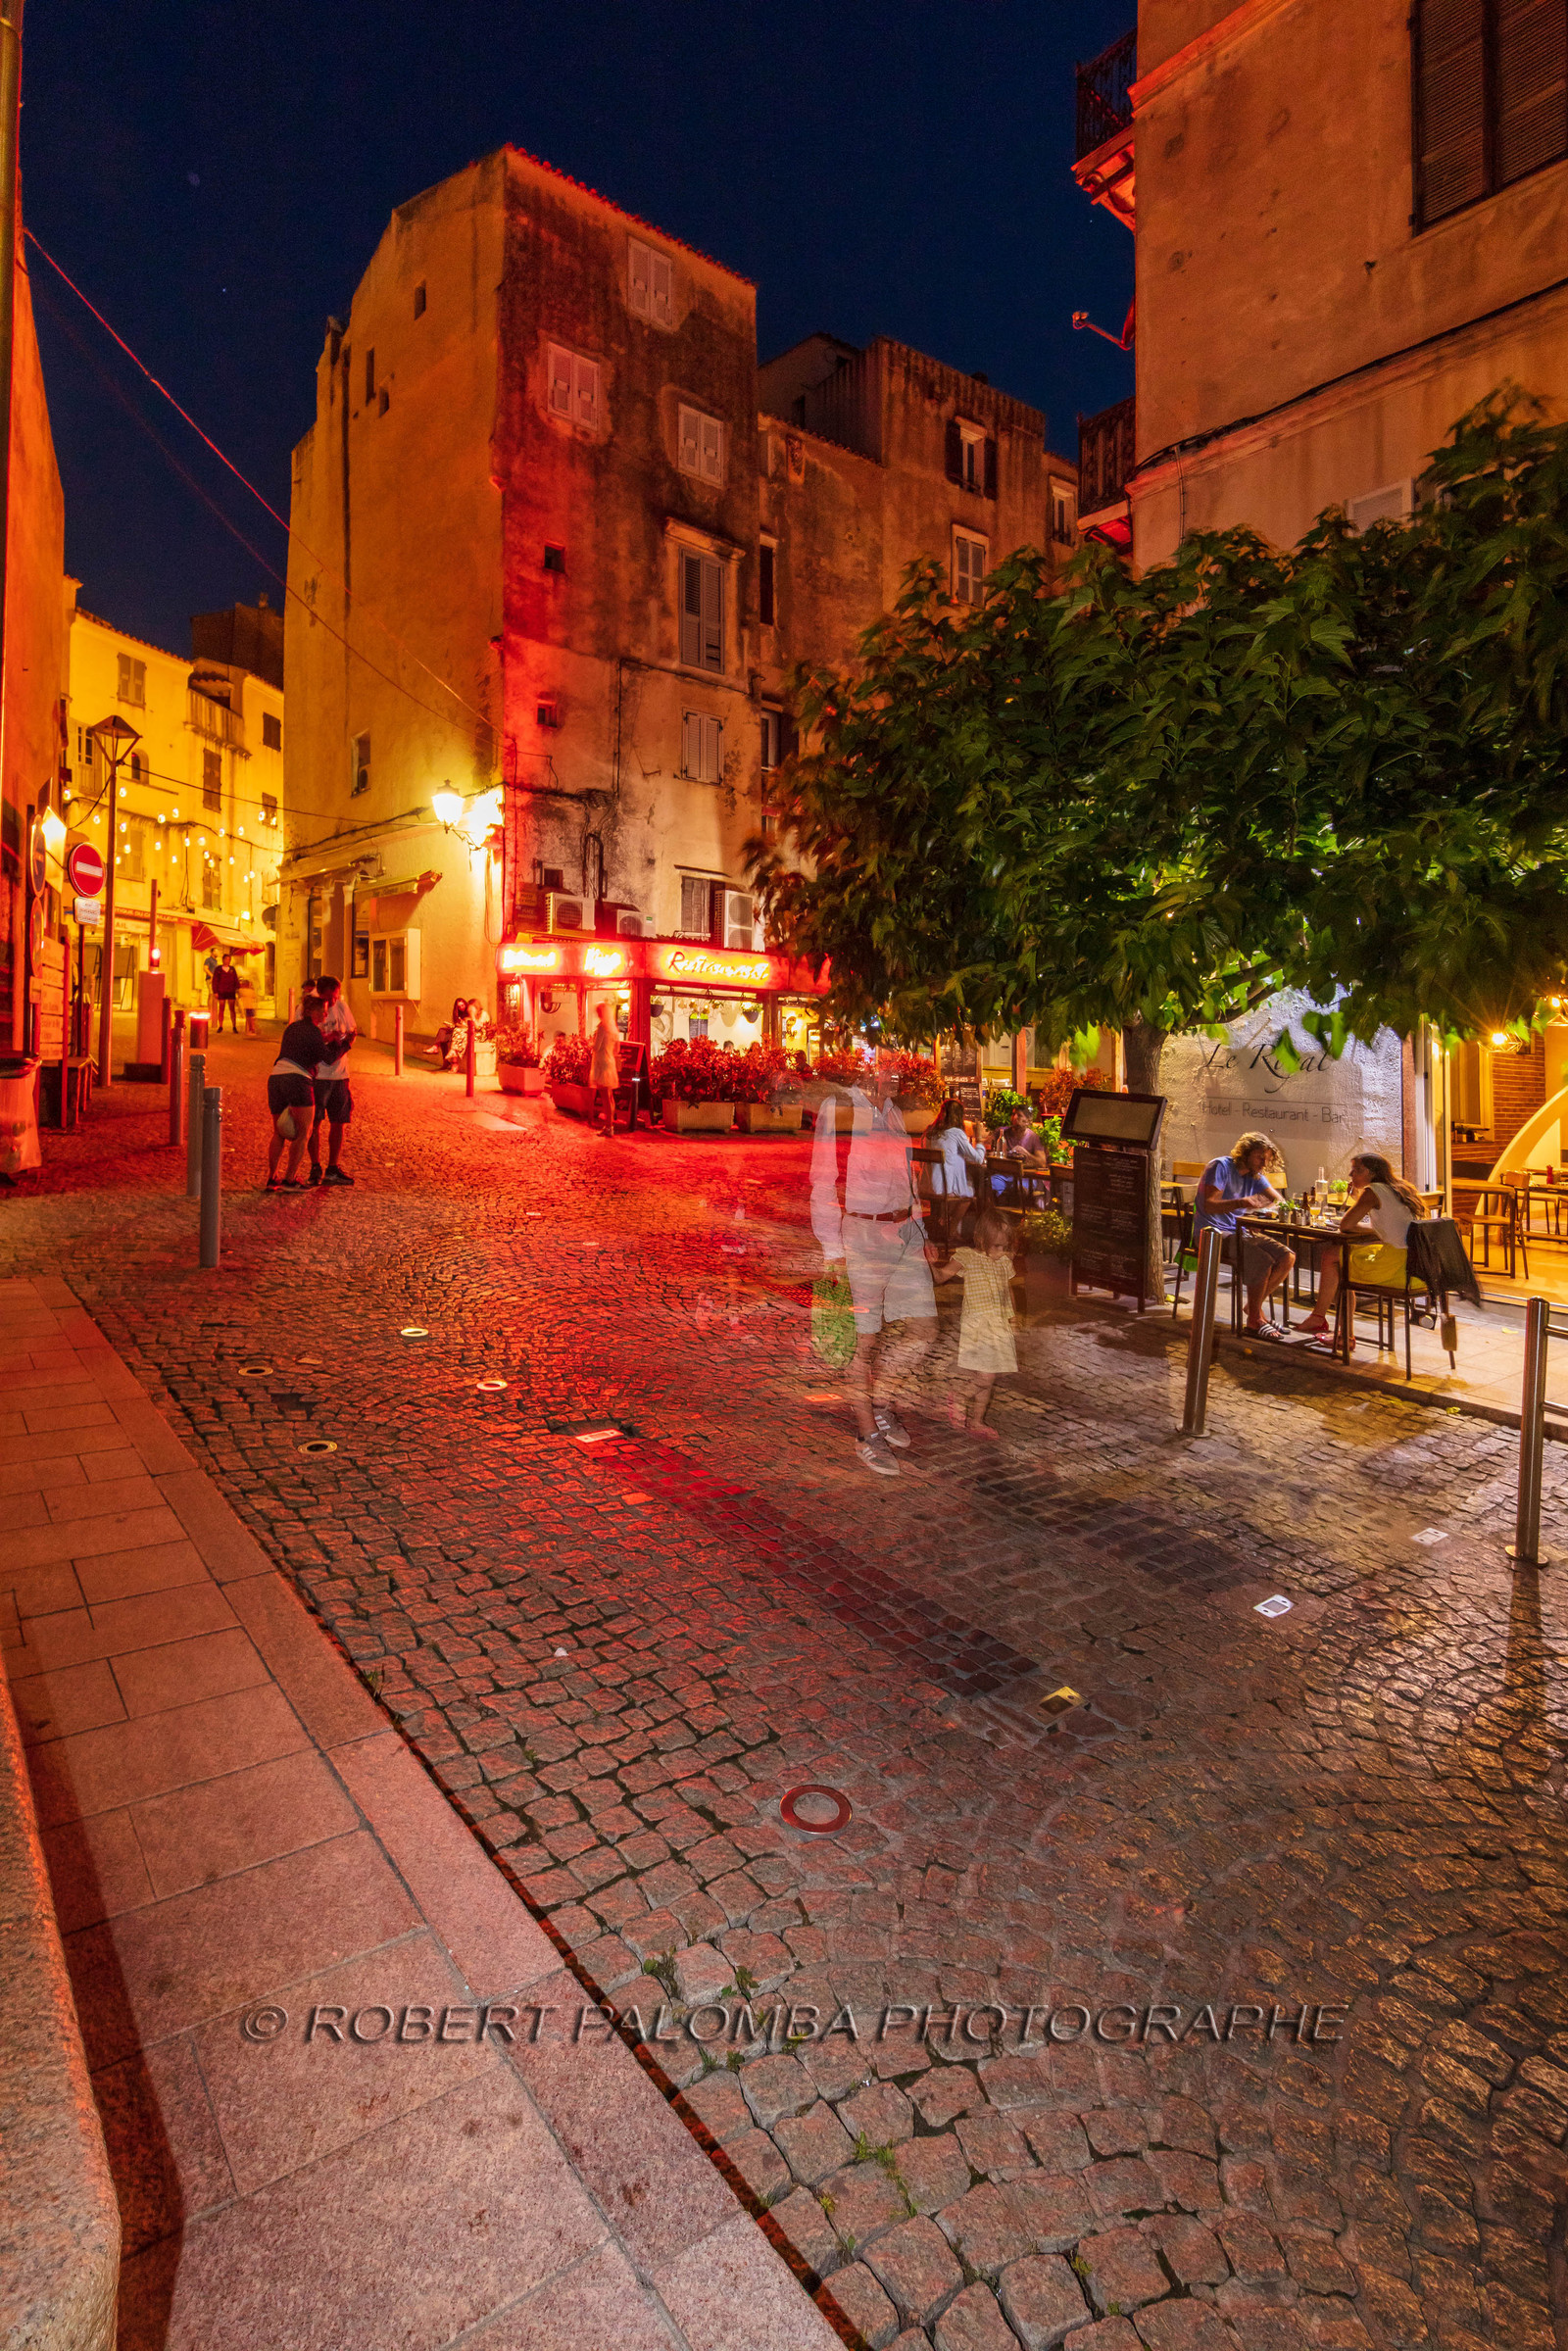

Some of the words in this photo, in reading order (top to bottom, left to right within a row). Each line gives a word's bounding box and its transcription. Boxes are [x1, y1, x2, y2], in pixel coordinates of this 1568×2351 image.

[668, 951, 770, 980] Restaurant
[1202, 1044, 1239, 1068] Le
[1242, 1102, 1309, 1122] Restaurant
[1321, 1106, 1345, 1124] Bar
